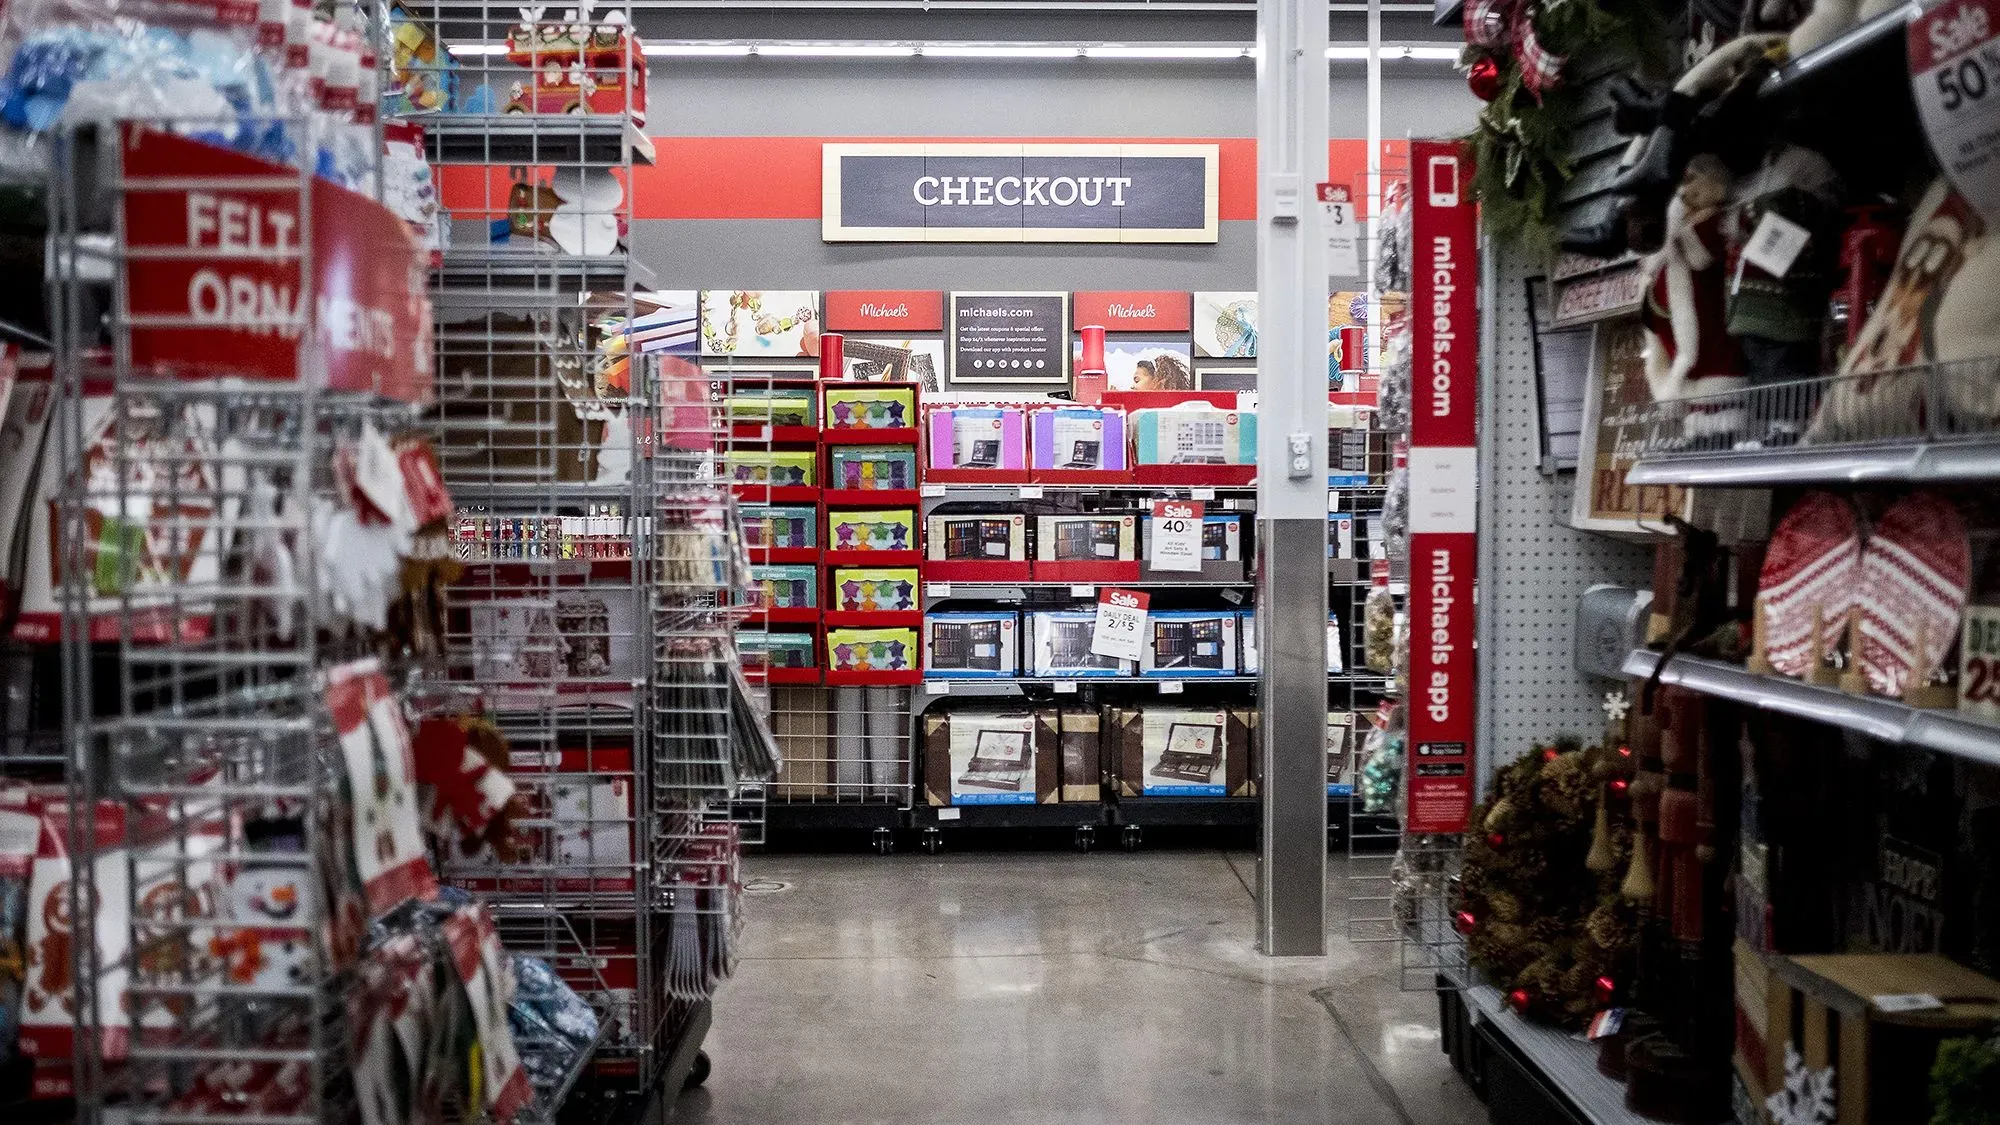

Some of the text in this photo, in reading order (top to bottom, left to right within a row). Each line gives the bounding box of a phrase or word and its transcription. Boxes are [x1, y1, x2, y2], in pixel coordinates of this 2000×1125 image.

[1929, 5, 1990, 61] Sale
[913, 176, 1132, 207] CHECKOUT
[187, 192, 295, 261] FELT
[859, 303, 909, 318] Michaels
[959, 308, 1034, 318] michaels.com
[1107, 303, 1156, 318] Michaels
[1432, 236, 1456, 417] michaels.com
[1164, 505, 1193, 518] Sale
[1110, 592, 1139, 608] Sale
[1431, 550, 1454, 665] michaels
[1103, 610, 1140, 624] DAILY DEAL
[1427, 671, 1450, 722] app
[1883, 849, 1937, 902] HOPE
